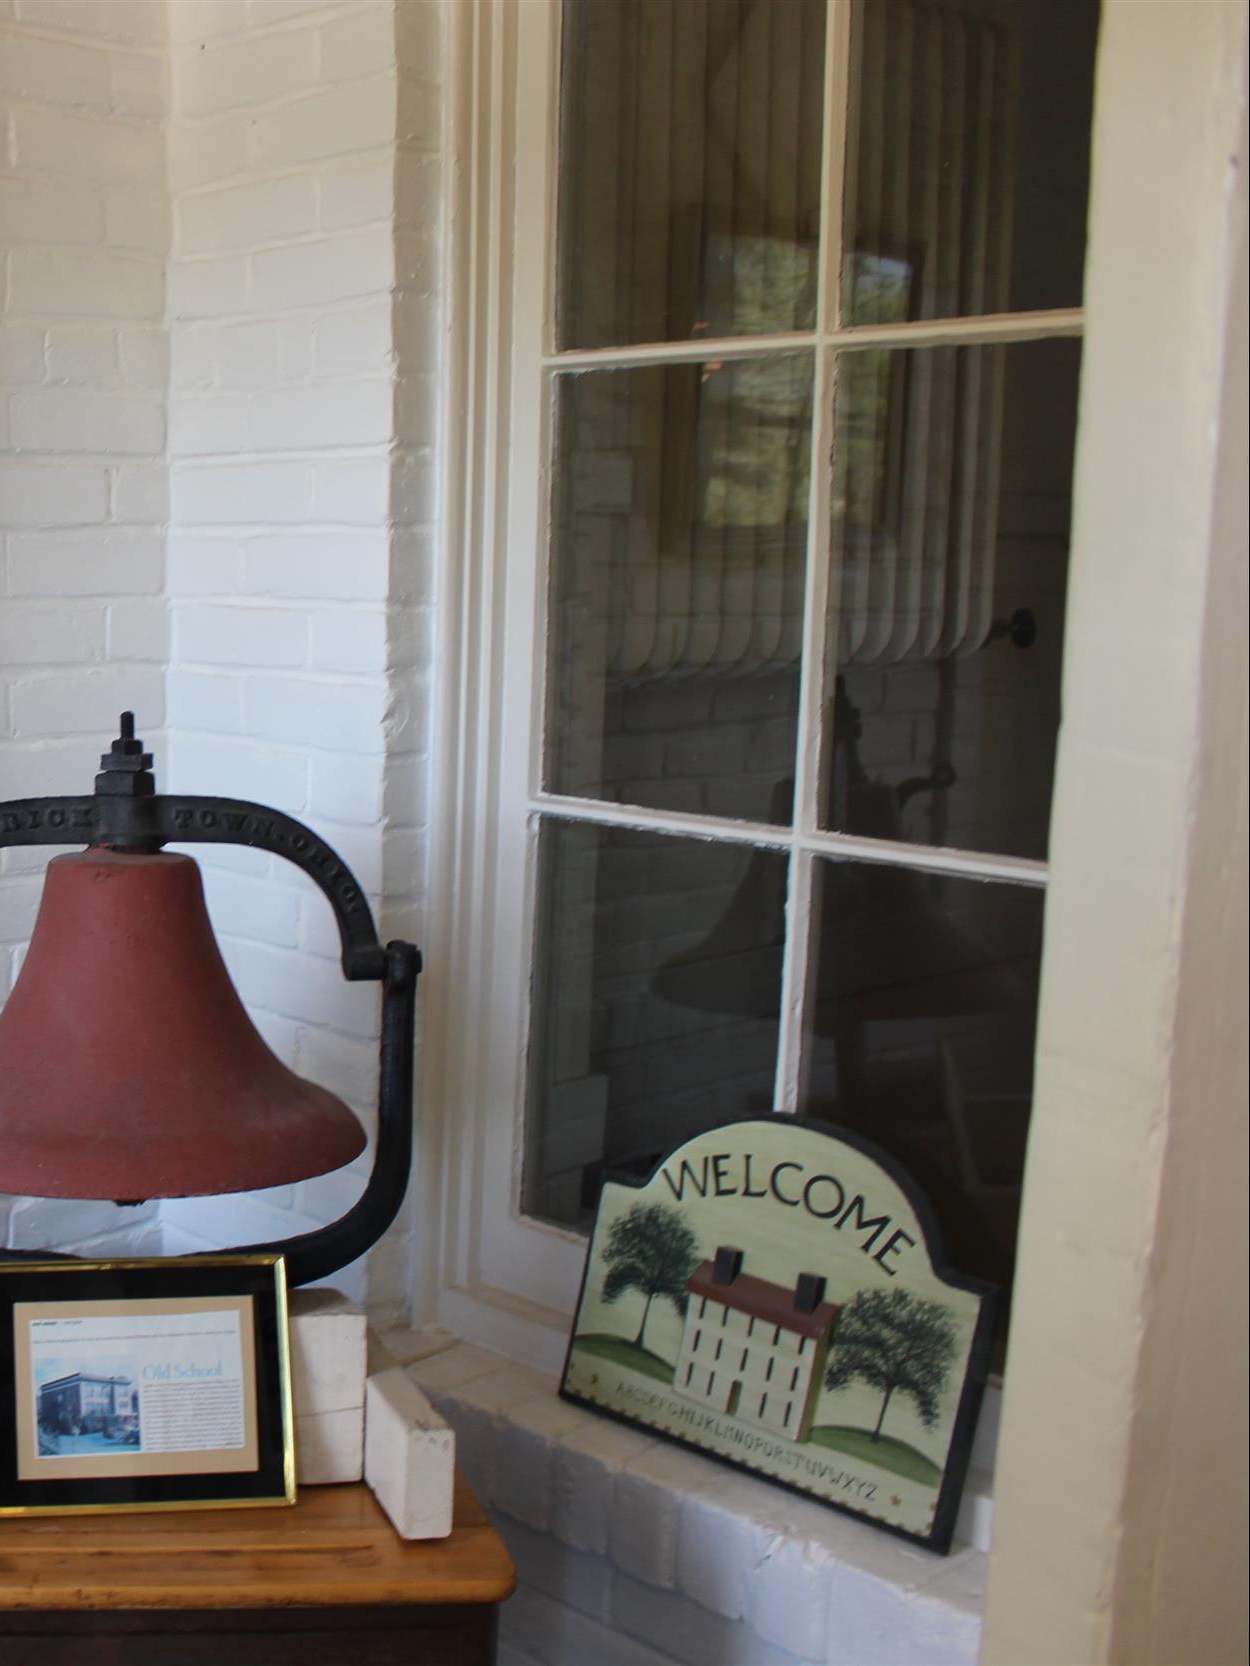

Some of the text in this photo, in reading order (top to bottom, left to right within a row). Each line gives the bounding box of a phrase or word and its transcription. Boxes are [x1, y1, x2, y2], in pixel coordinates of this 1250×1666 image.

[662, 1153, 916, 1277] WELCOME
[141, 1359, 223, 1380] Old School
